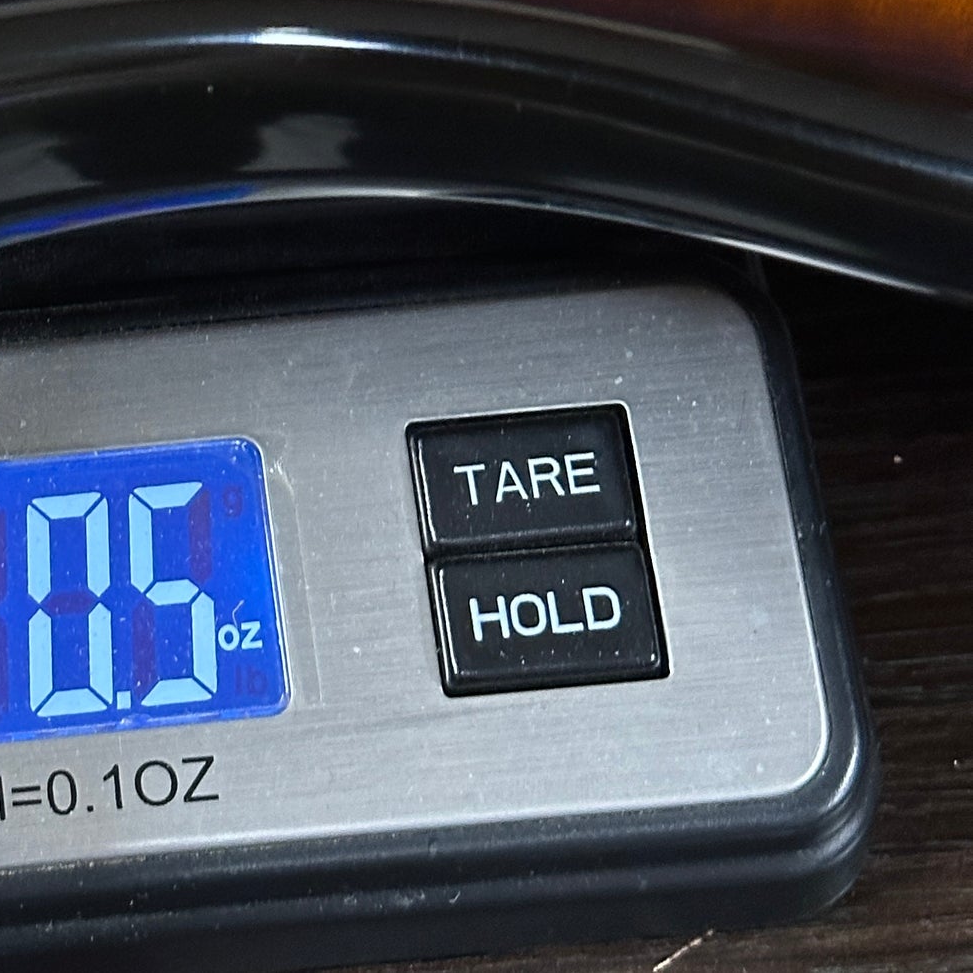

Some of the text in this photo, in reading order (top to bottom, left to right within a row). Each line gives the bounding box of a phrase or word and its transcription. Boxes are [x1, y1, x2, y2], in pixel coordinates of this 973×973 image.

[453, 451, 601, 506] TARE
[28, 481, 218, 717] 0.5
[217, 620, 264, 651] oz
[468, 585, 623, 642] HOLD
